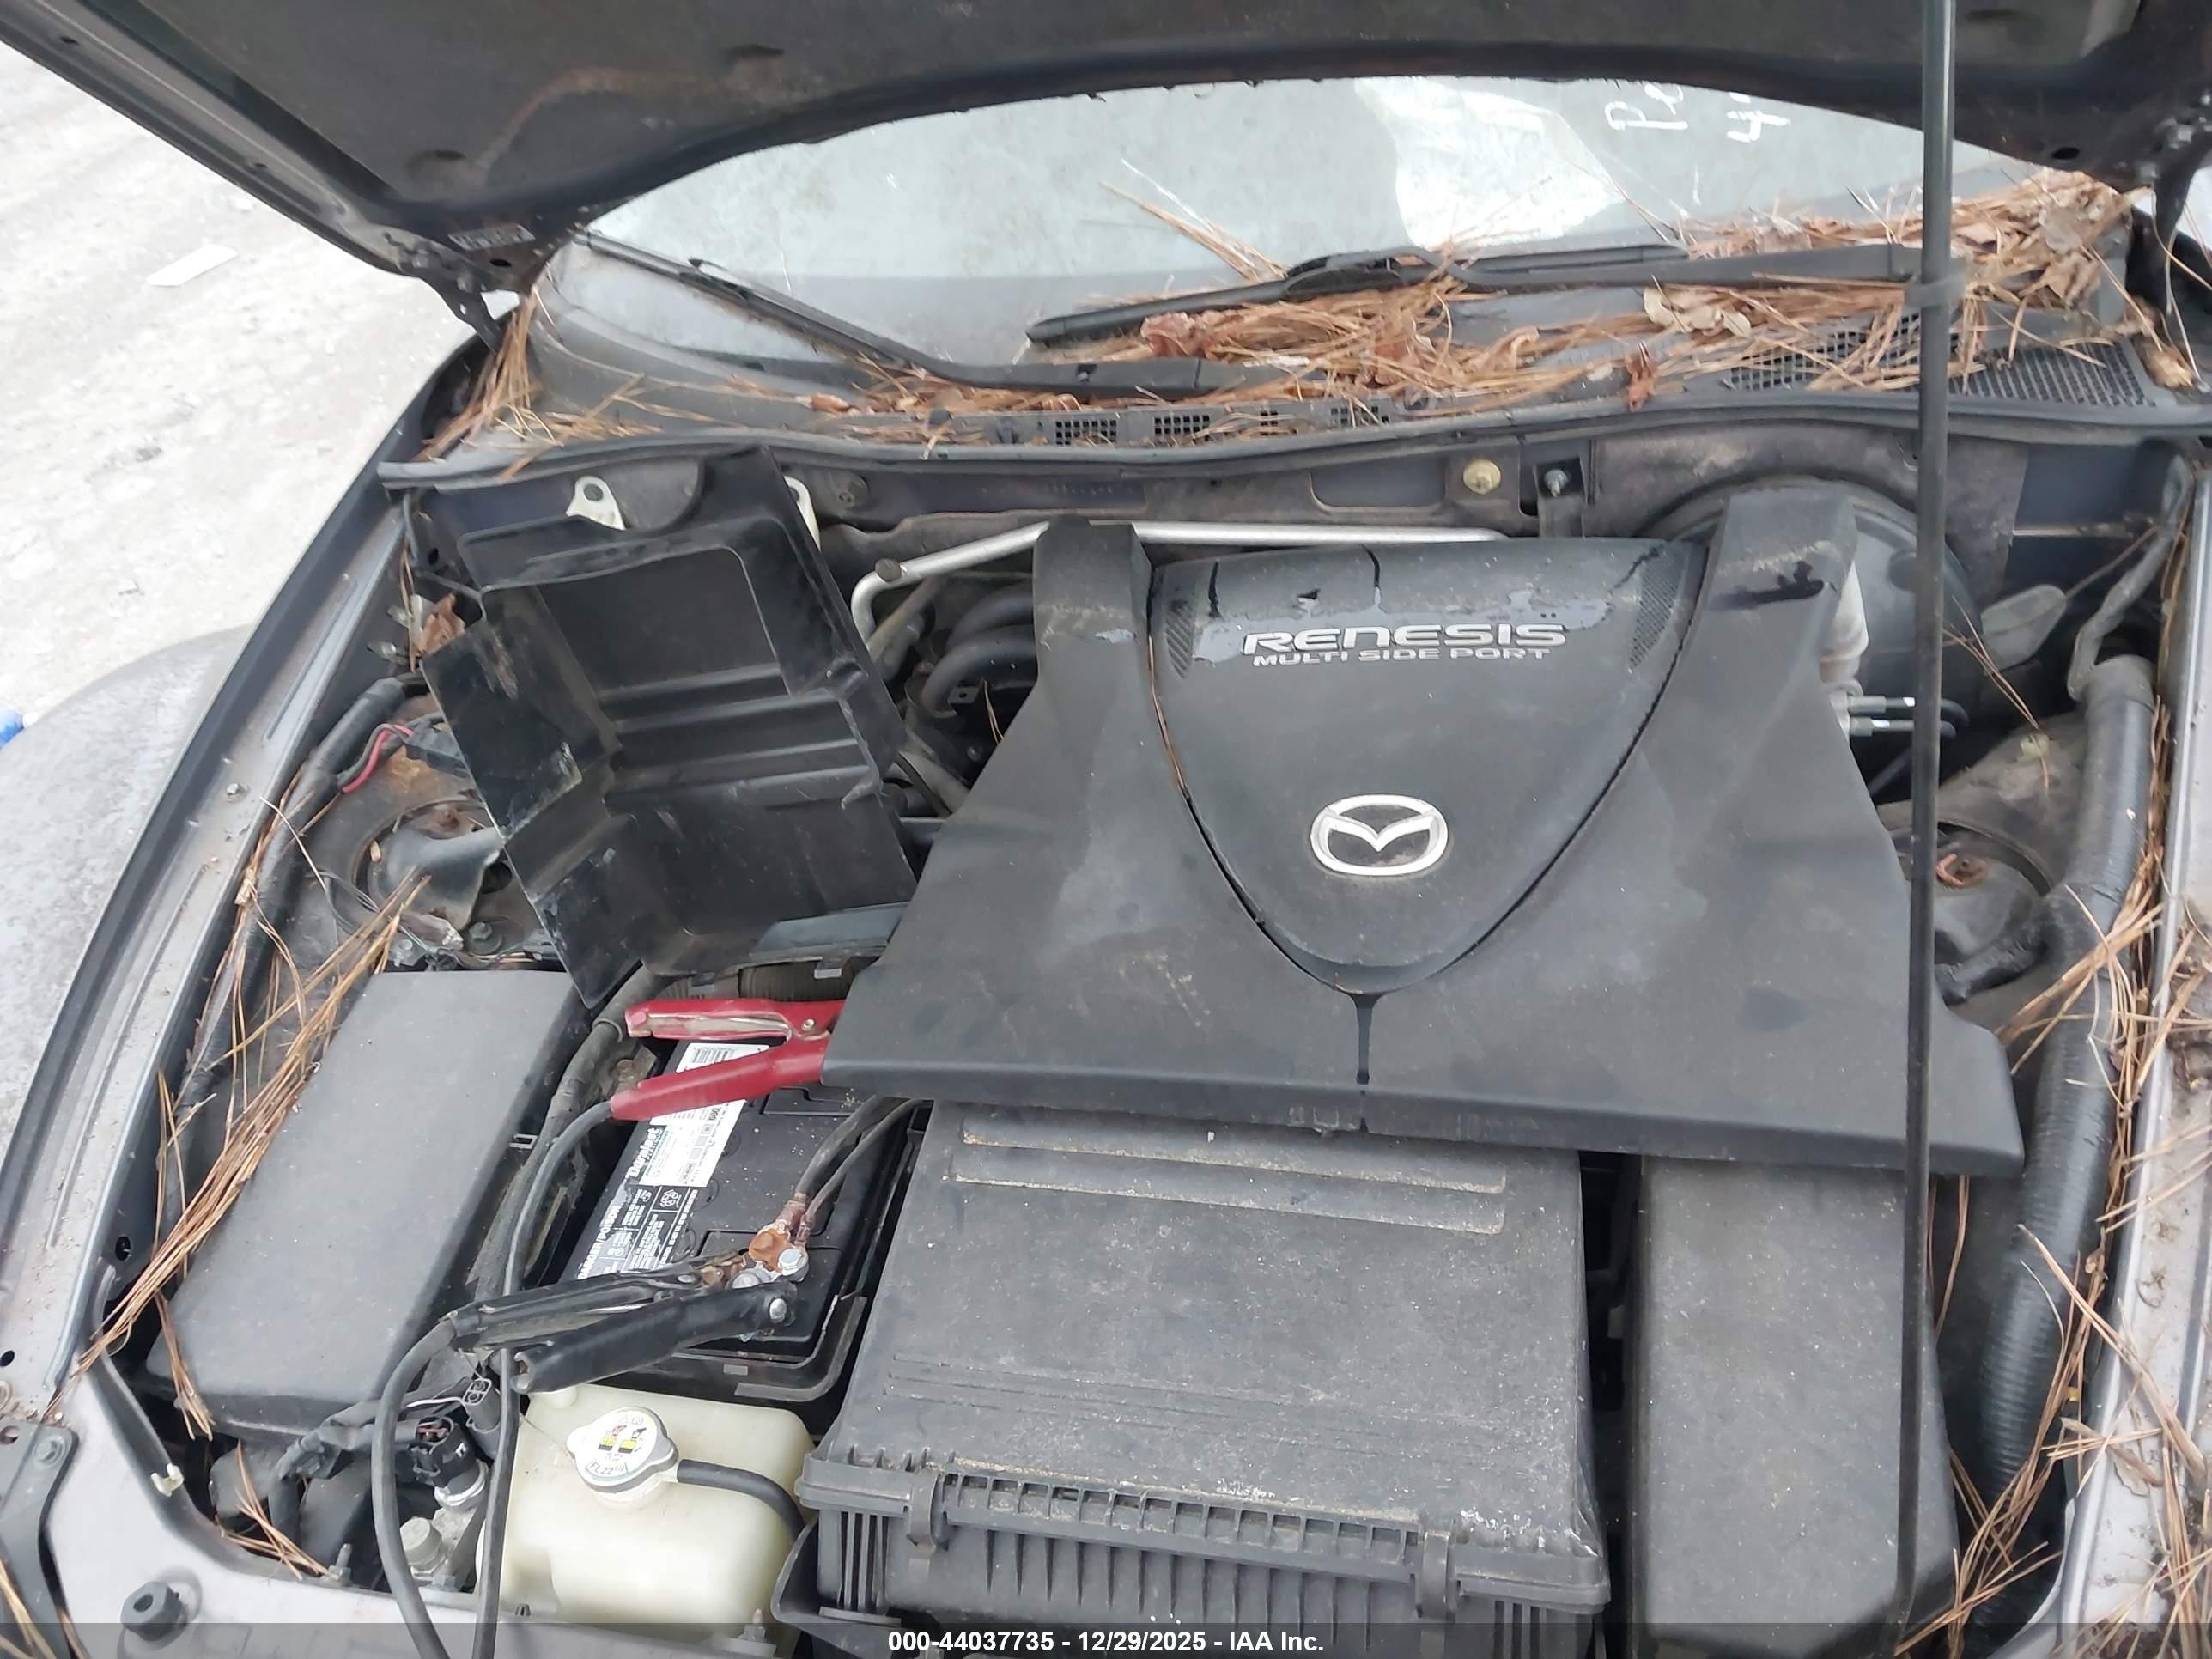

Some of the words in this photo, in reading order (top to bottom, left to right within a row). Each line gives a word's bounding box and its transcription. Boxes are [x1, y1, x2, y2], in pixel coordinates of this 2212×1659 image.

[1243, 624, 1567, 655] RENESIS
[1253, 651, 1348, 667] MULTI
[1358, 648, 1440, 661] SIDE
[1450, 647, 1551, 659] PORT
[589, 1462, 614, 1474] FL22
